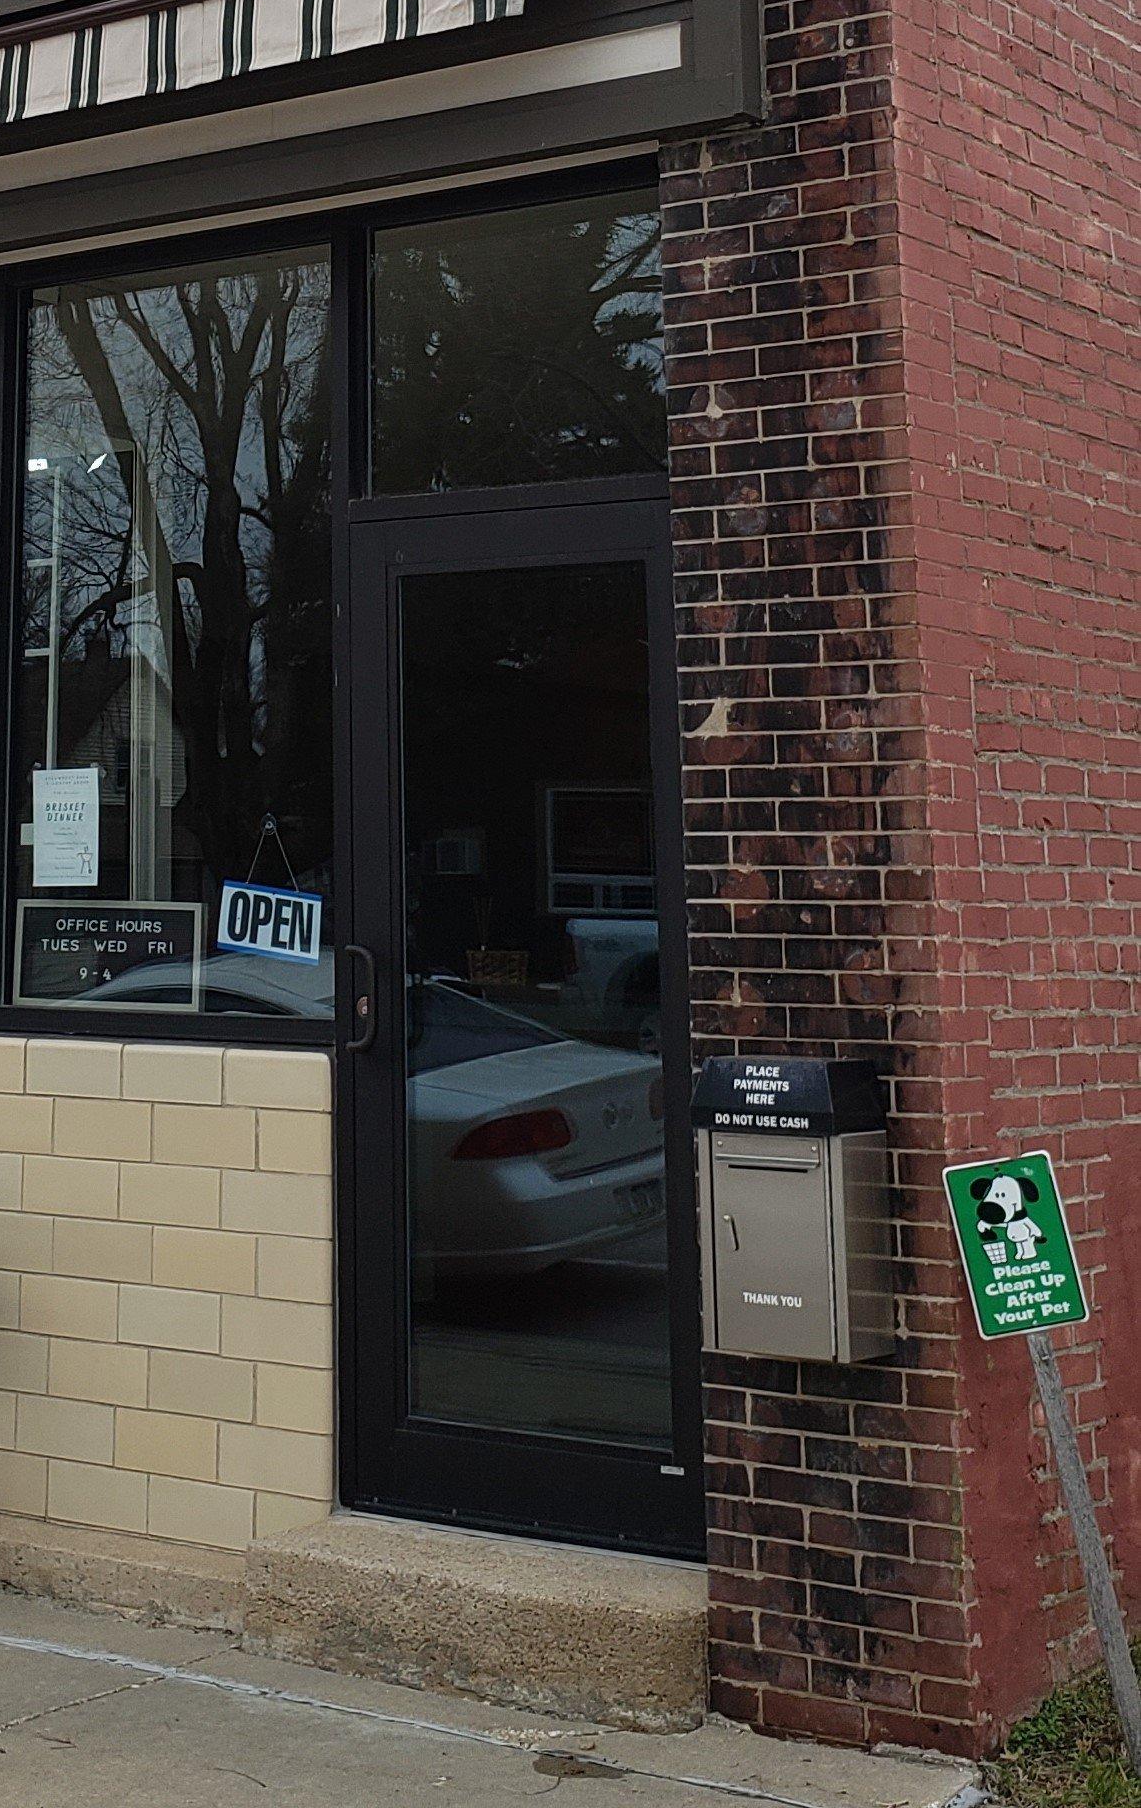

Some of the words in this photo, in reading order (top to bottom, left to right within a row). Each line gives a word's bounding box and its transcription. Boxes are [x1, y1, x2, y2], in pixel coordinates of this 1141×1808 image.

[45, 802, 86, 812] BRISKET
[47, 812, 84, 822] DINNER
[55, 918, 109, 933] OFFICE
[115, 919, 162, 934] HOURS
[226, 889, 315, 955] OPEN
[40, 938, 80, 953] TUES
[94, 939, 127, 954] WED
[147, 940, 174, 955] FRI
[79, 966, 88, 980] 9
[103, 967, 112, 981] 4
[745, 1065, 780, 1078] PLACE
[733, 1078, 790, 1092] PAYMENTS
[745, 1092, 775, 1105] HERE
[715, 1112, 730, 1125] DO
[732, 1114, 754, 1127] NOT
[755, 1115, 778, 1128] USE
[779, 1116, 809, 1129] CASH
[992, 1260, 1051, 1280] Please
[985, 1279, 1036, 1296] Clean
[1040, 1273, 1066, 1287] Up
[742, 1291, 779, 1307] THANK
[780, 1293, 802, 1308] YOU
[1006, 1290, 1052, 1308] After
[993, 1308, 1036, 1325] Your
[1041, 1301, 1071, 1317] Pet
